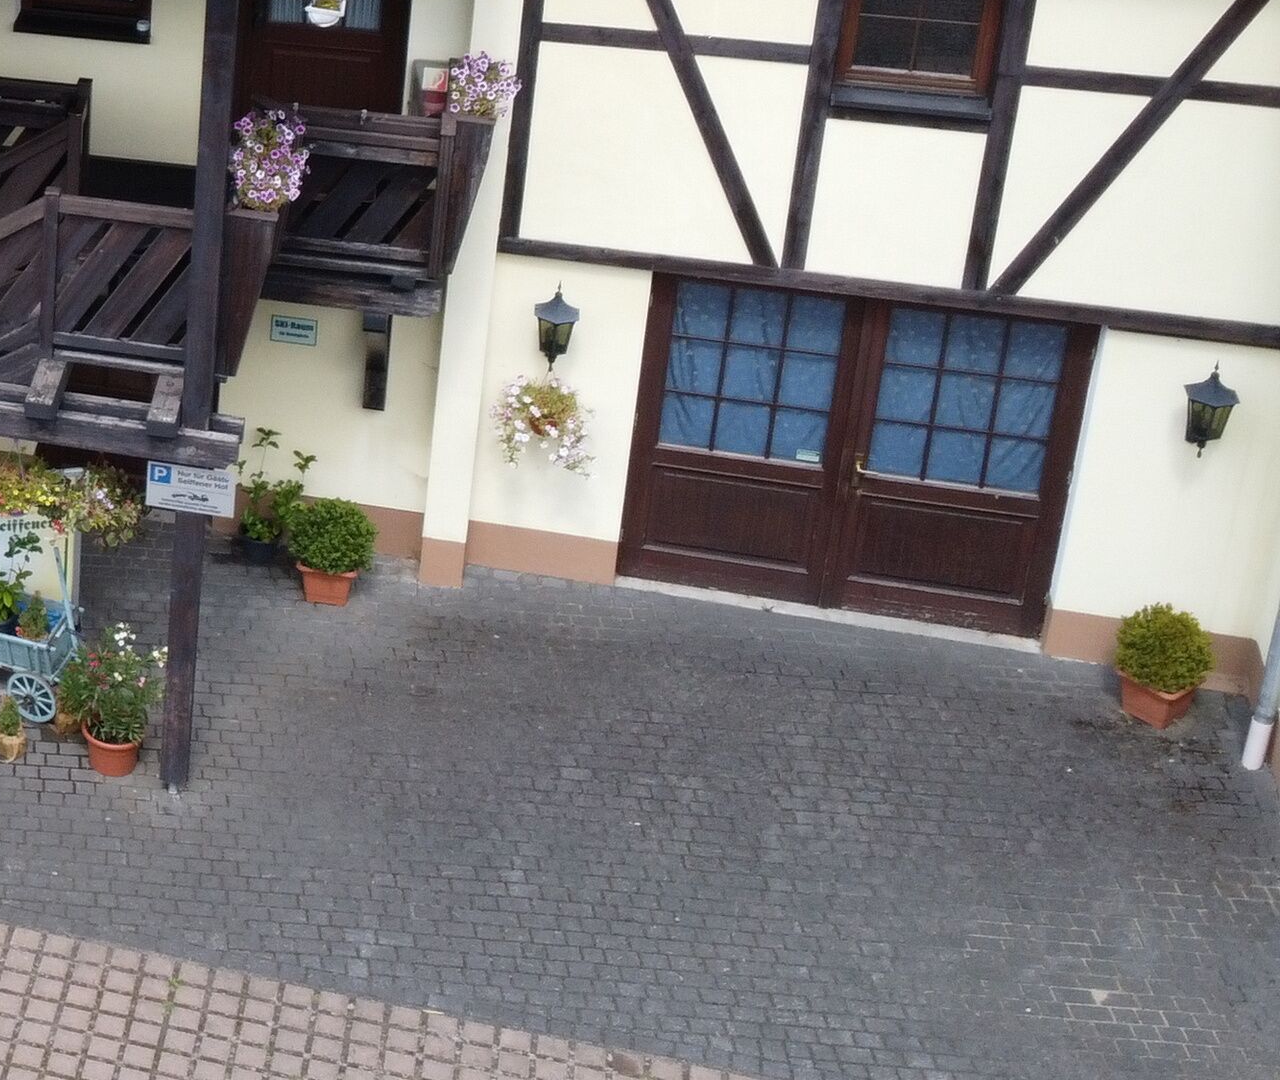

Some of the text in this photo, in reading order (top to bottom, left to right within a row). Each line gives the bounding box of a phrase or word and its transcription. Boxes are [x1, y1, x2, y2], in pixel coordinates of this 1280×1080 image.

[153, 466, 168, 481] P
[177, 469, 192, 478] Nur
[193, 471, 205, 480] für
[214, 482, 229, 490] Hof
